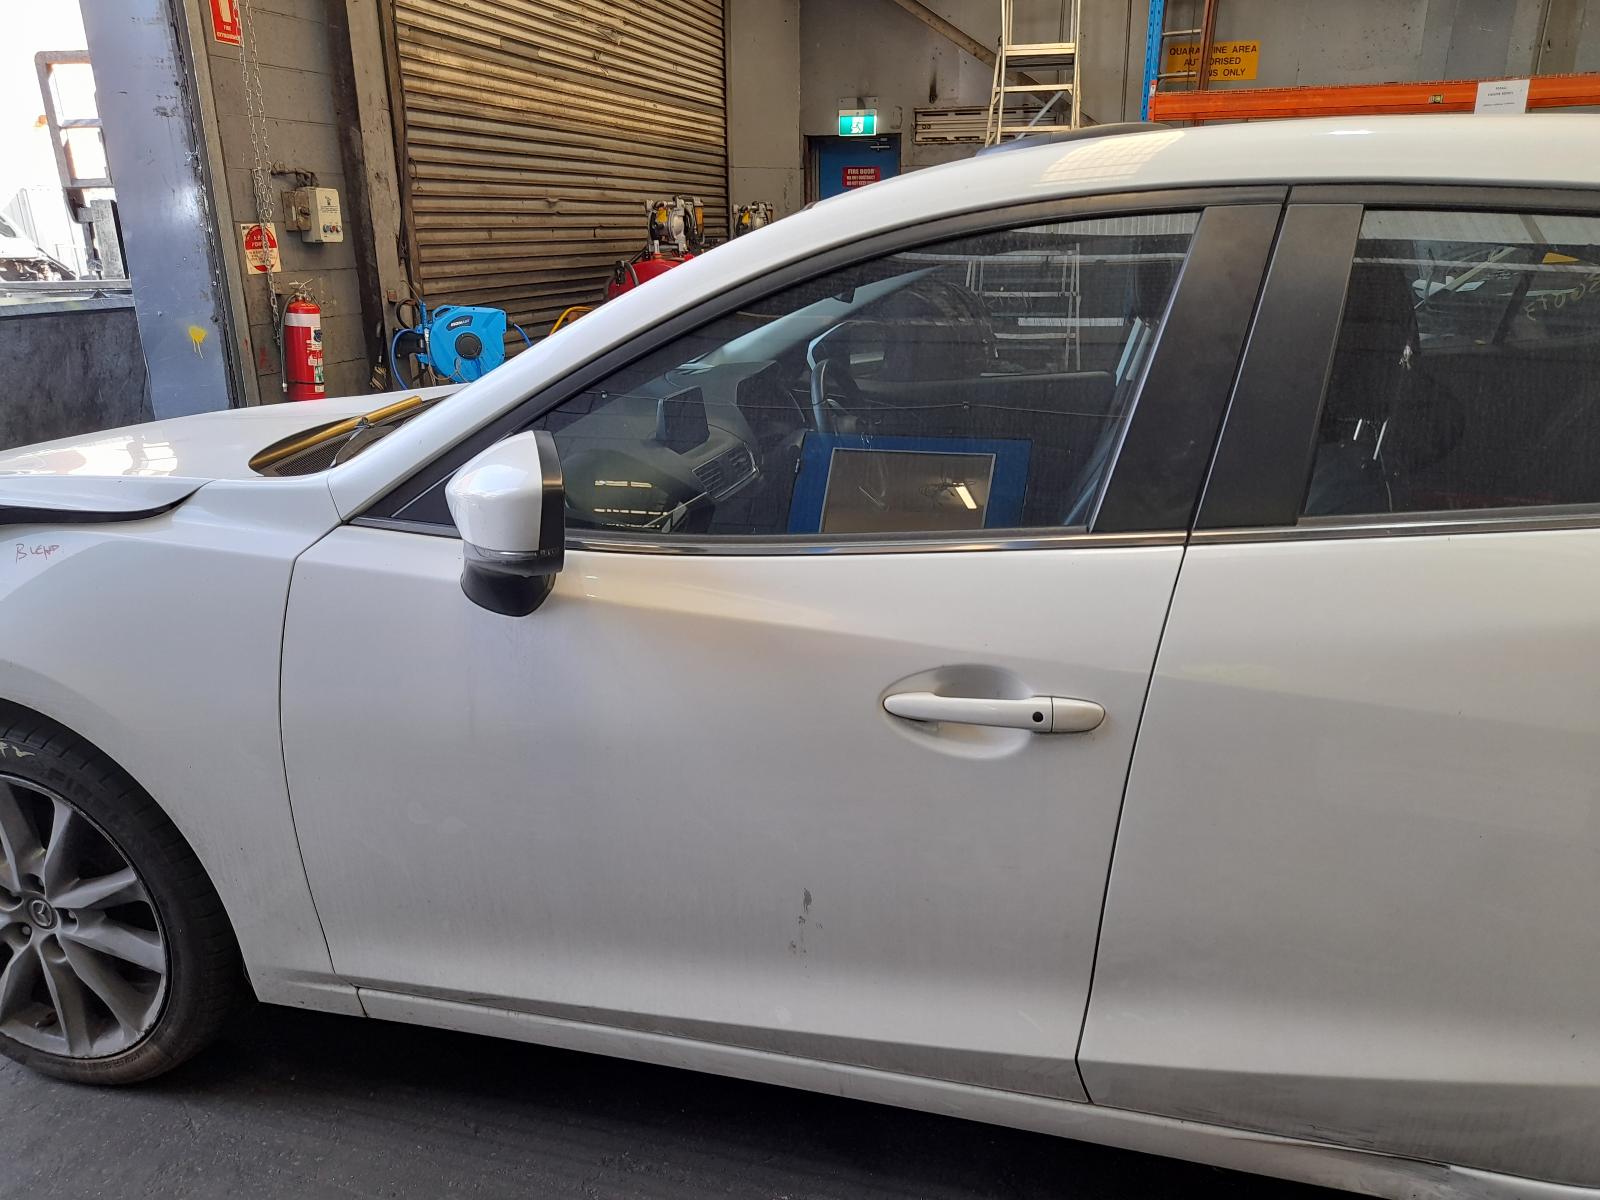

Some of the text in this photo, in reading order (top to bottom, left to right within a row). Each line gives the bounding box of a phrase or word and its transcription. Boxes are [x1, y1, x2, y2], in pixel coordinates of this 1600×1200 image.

[1169, 45, 1257, 56] QUARAINE AREA
[1183, 57, 1242, 66] AUORISED
[1222, 69, 1246, 77] ONLY
